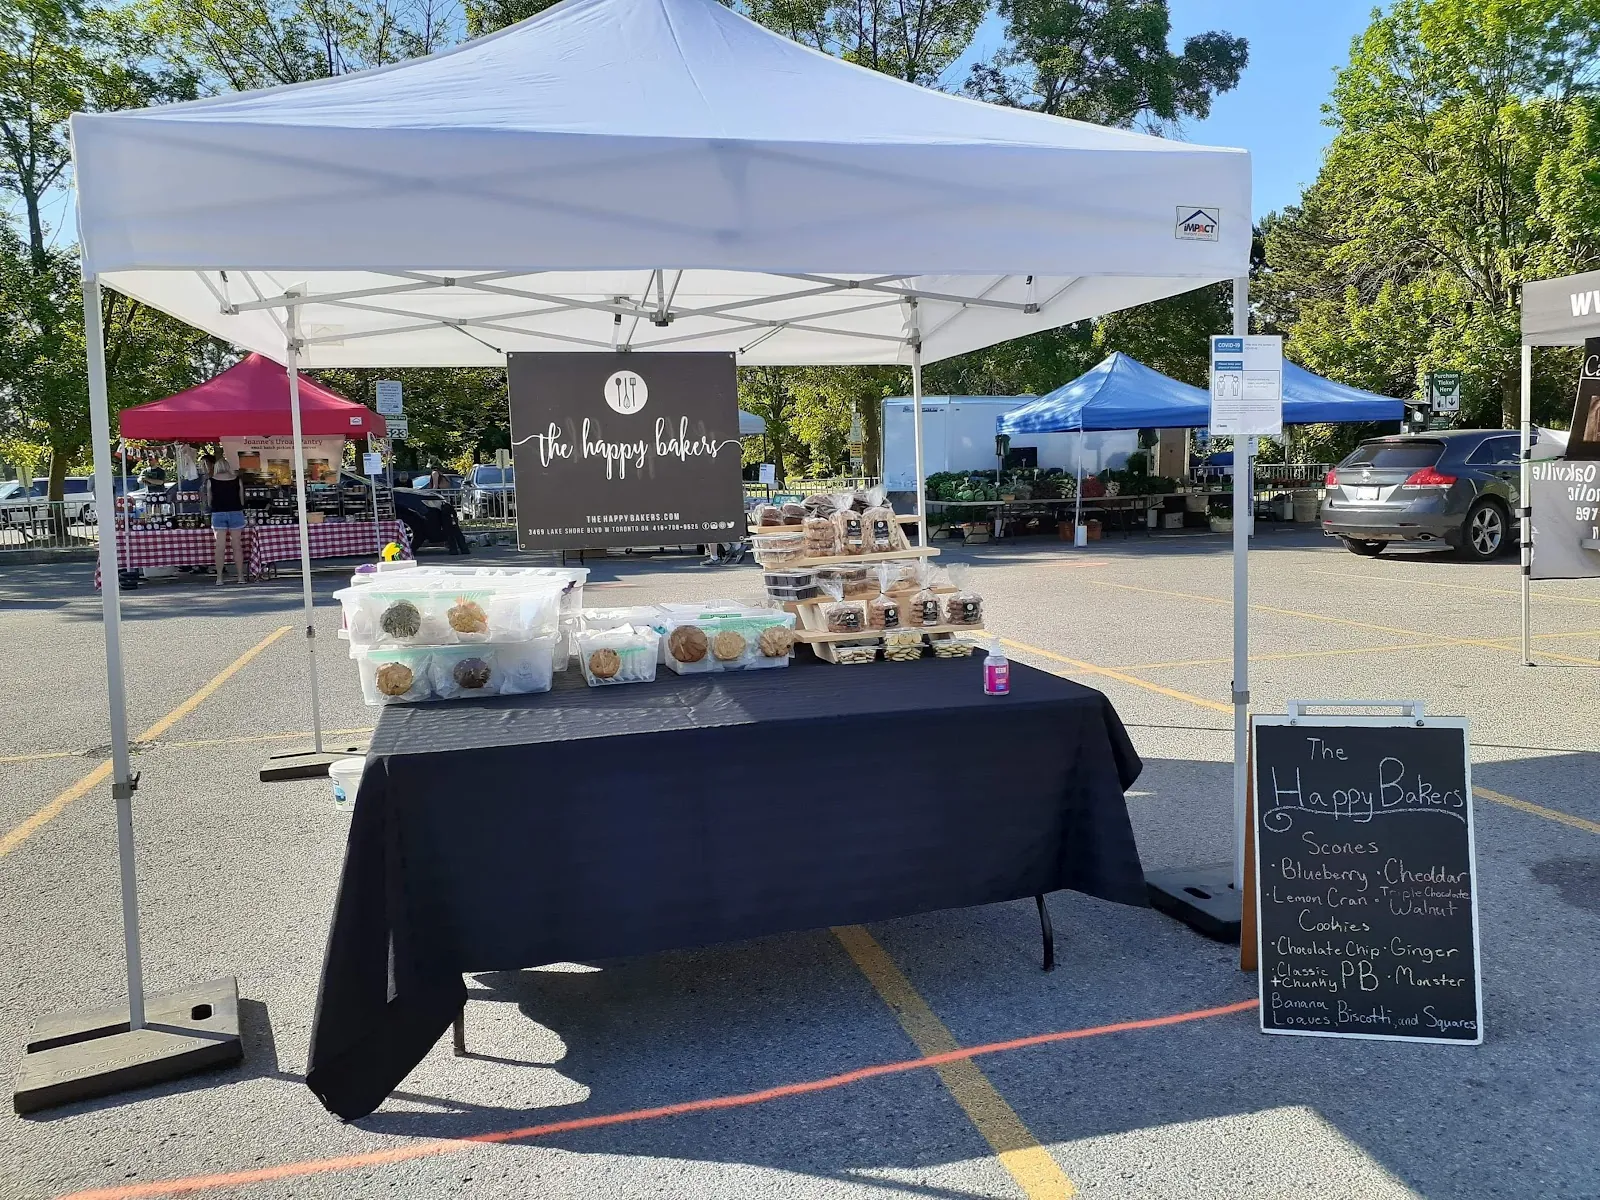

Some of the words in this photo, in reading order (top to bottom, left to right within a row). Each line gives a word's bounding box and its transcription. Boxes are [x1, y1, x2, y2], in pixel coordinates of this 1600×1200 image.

[538, 422, 573, 468] the
[582, 417, 649, 480] happy
[655, 415, 718, 462] bakers
[528, 528, 545, 536] 3469
[564, 527, 585, 535] SHORE
[586, 526, 602, 534] BLVD
[612, 525, 639, 533] TORONTO
[1306, 737, 1349, 761] The
[1271, 766, 1374, 823] Happy
[1378, 756, 1464, 808] Bakers
[1301, 831, 1379, 855] Scones
[1281, 856, 1368, 892] Blueberry
[1384, 857, 1468, 885] Cheddar
[1273, 885, 1323, 906] Lemon
[1327, 887, 1368, 908] Cran
[1379, 886, 1422, 902] Triple
[1424, 886, 1471, 900] Chocolate
[1389, 899, 1459, 917] Walnut
[1298, 908, 1371, 933] Cookies
[1277, 935, 1343, 956] Chocolate
[1345, 940, 1380, 960] Chip
[1390, 936, 1460, 964] Ginger
[1277, 961, 1329, 978] Classic
[1341, 959, 1380, 992] PB
[1395, 965, 1466, 987] Monster
[1271, 991, 1330, 1012] Banana
[1423, 1005, 1477, 1033] Squares
